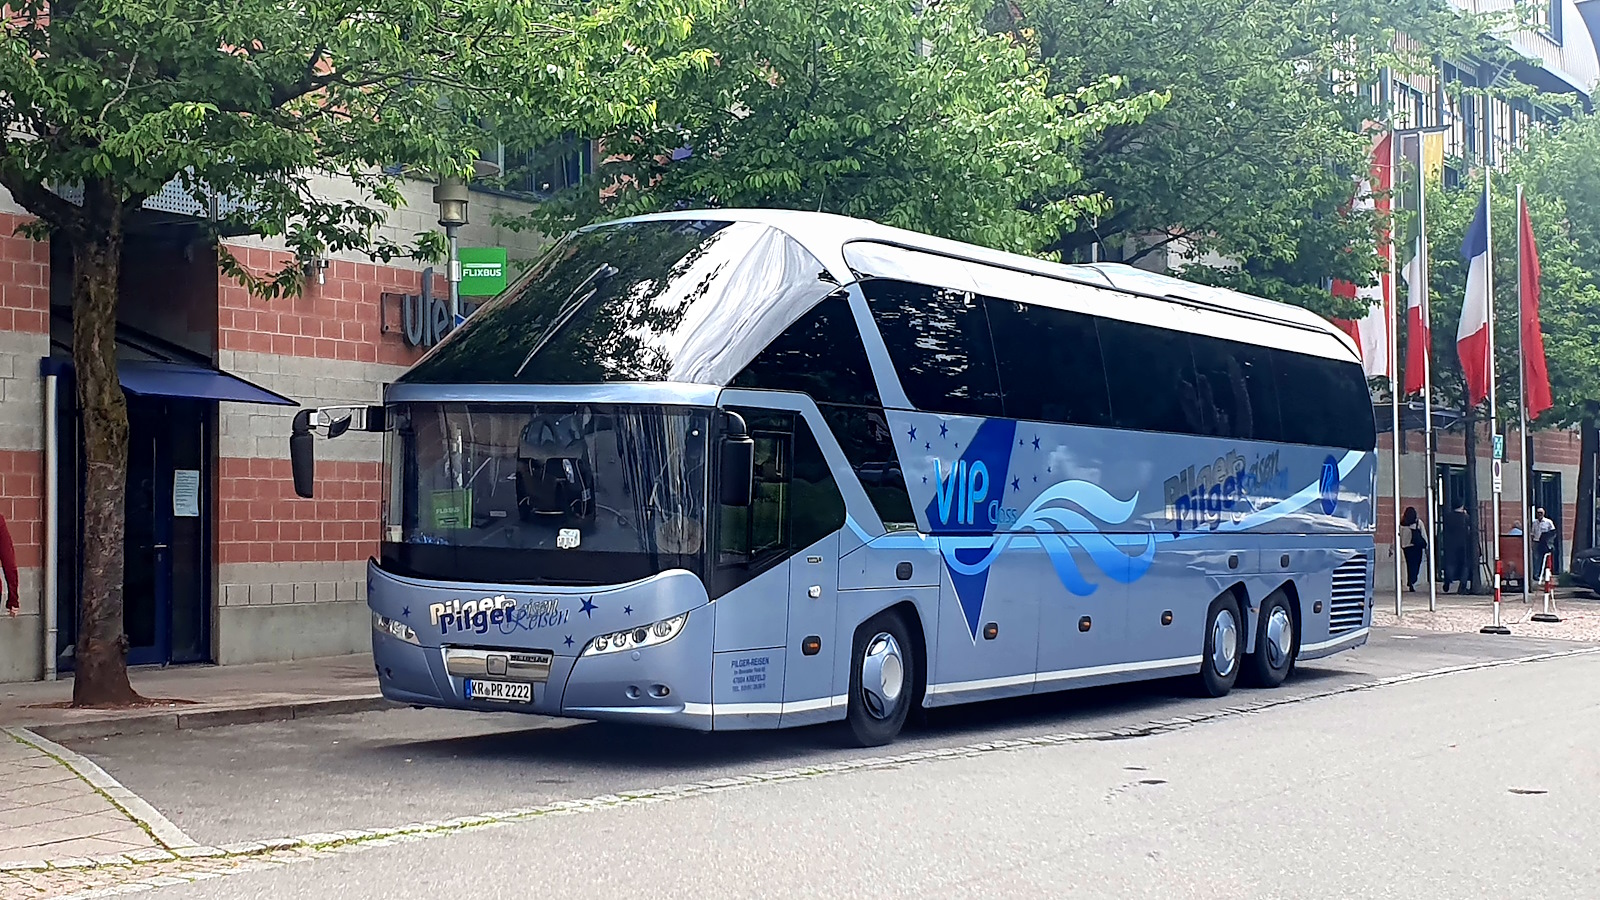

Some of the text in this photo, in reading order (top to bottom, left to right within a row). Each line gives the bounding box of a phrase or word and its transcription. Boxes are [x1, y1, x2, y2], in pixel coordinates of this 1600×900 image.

[462, 268, 502, 277] FLIXBUS
[933, 457, 989, 525] VIP
[439, 604, 516, 635] Pilger
[472, 681, 529, 698] KR PR 2222
